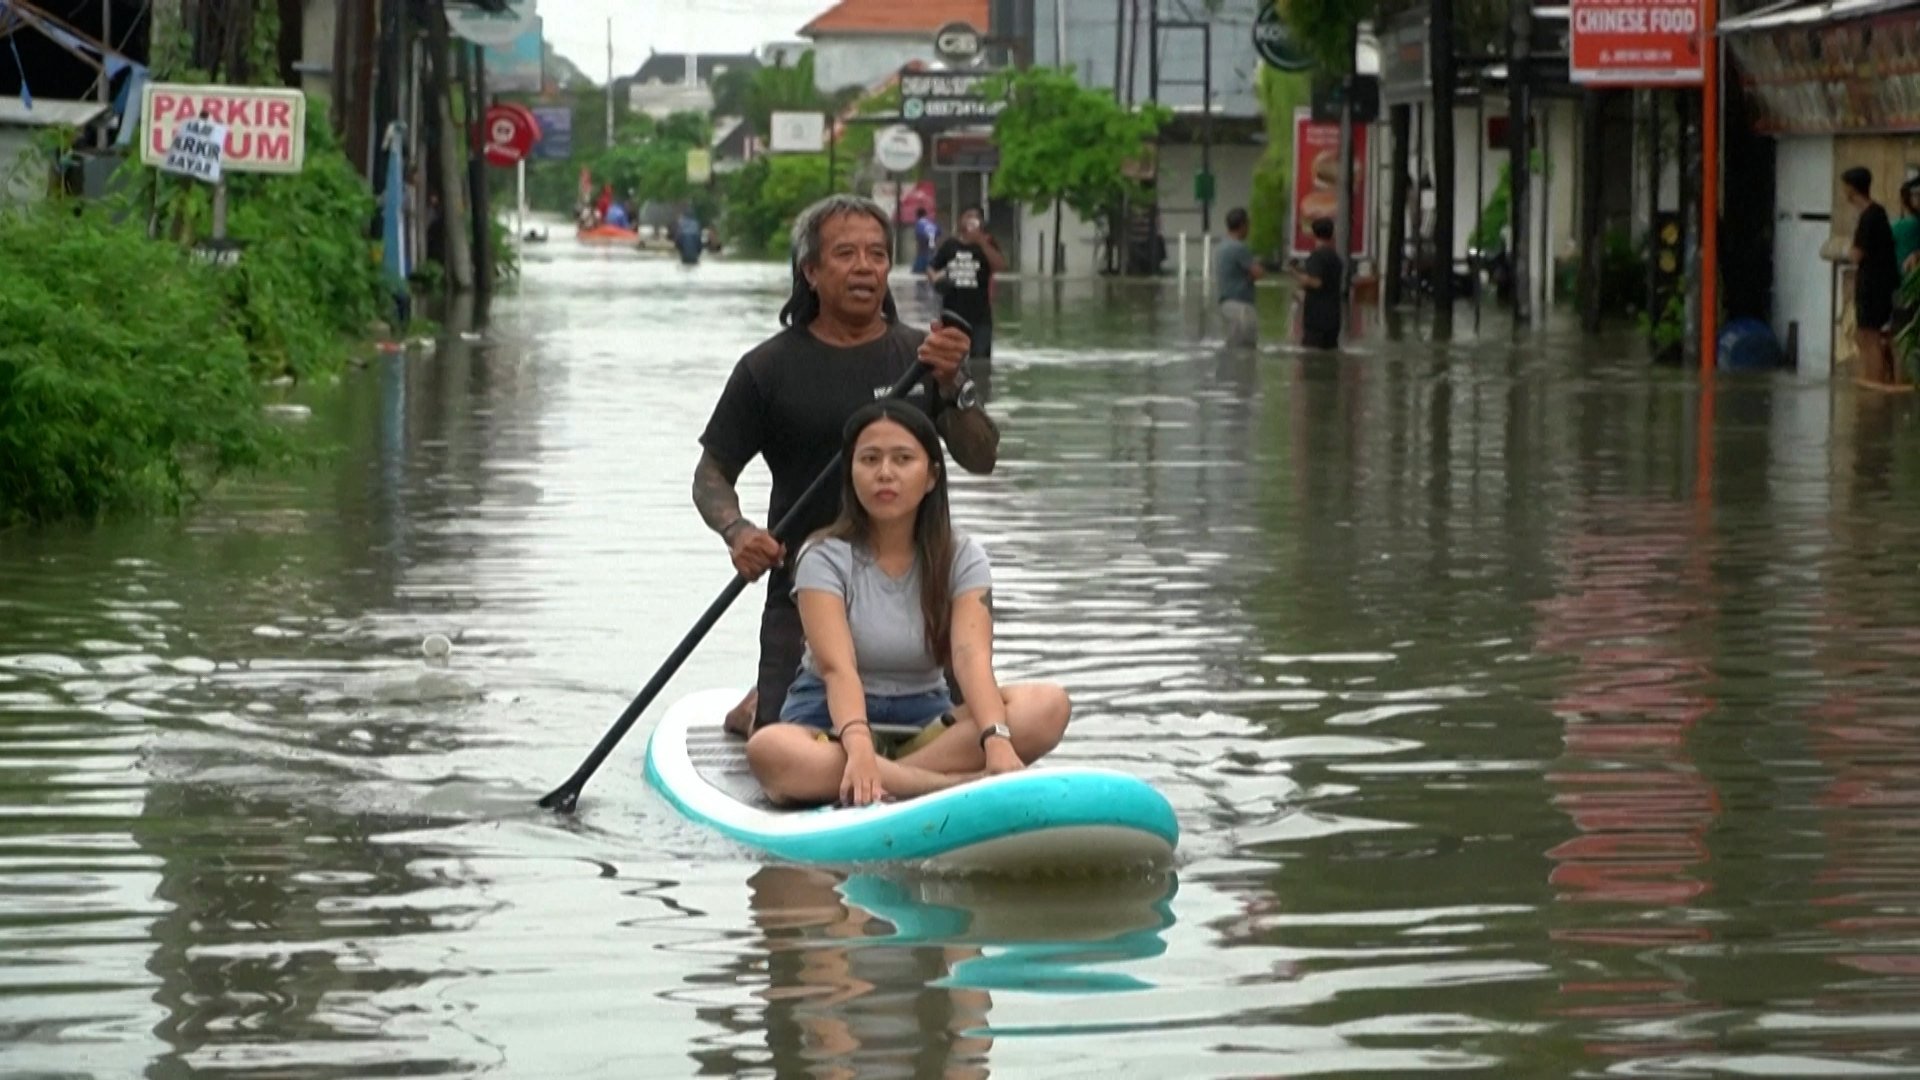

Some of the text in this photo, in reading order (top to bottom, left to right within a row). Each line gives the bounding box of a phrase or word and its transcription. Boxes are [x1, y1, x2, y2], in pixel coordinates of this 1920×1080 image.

[1576, 7, 1696, 34] CHINESE FOOD
[153, 95, 290, 128] PARKIR
[152, 127, 290, 161] UUM
